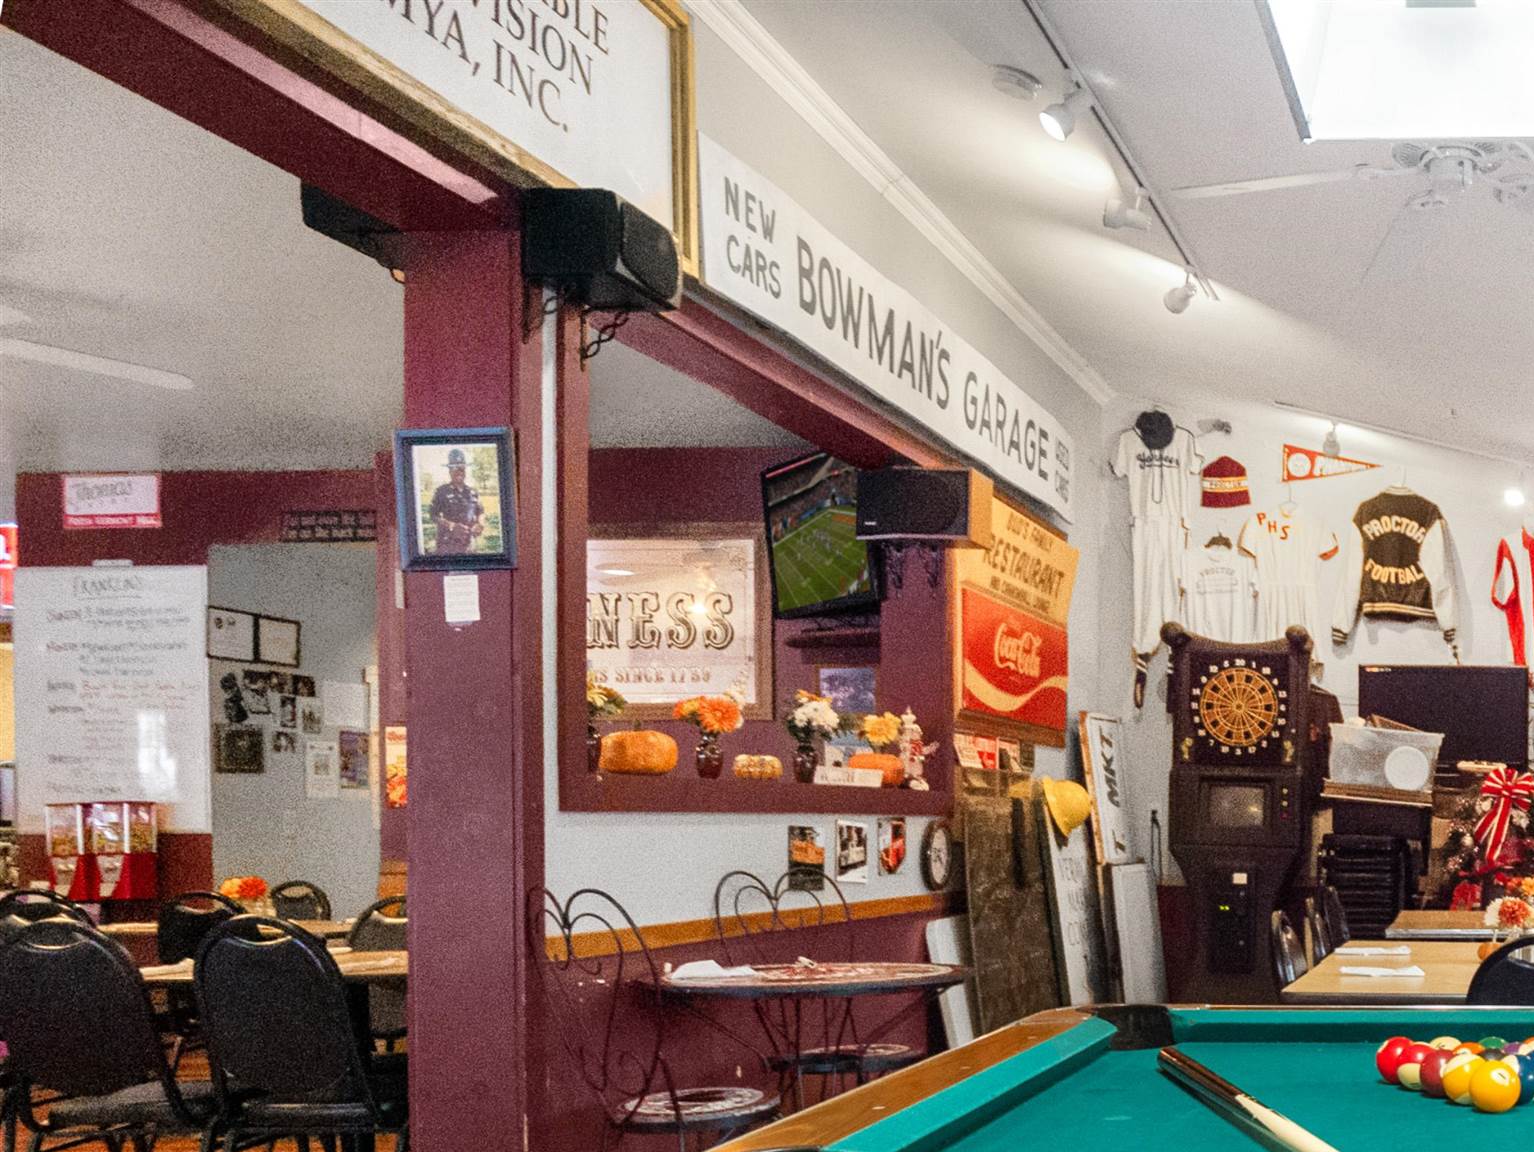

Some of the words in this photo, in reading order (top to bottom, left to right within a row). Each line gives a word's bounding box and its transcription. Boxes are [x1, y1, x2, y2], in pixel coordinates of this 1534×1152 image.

[492, 38, 569, 133] INC.
[724, 175, 776, 244] NEW
[726, 234, 782, 300] CARS
[797, 234, 951, 411] BOWMAN'S
[963, 370, 1050, 481] GARAGE
[1256, 512, 1291, 540] PHS
[1362, 514, 1427, 544] PROCTOR
[983, 533, 1065, 599] RESTAURANT
[615, 666, 665, 684] SINCE
